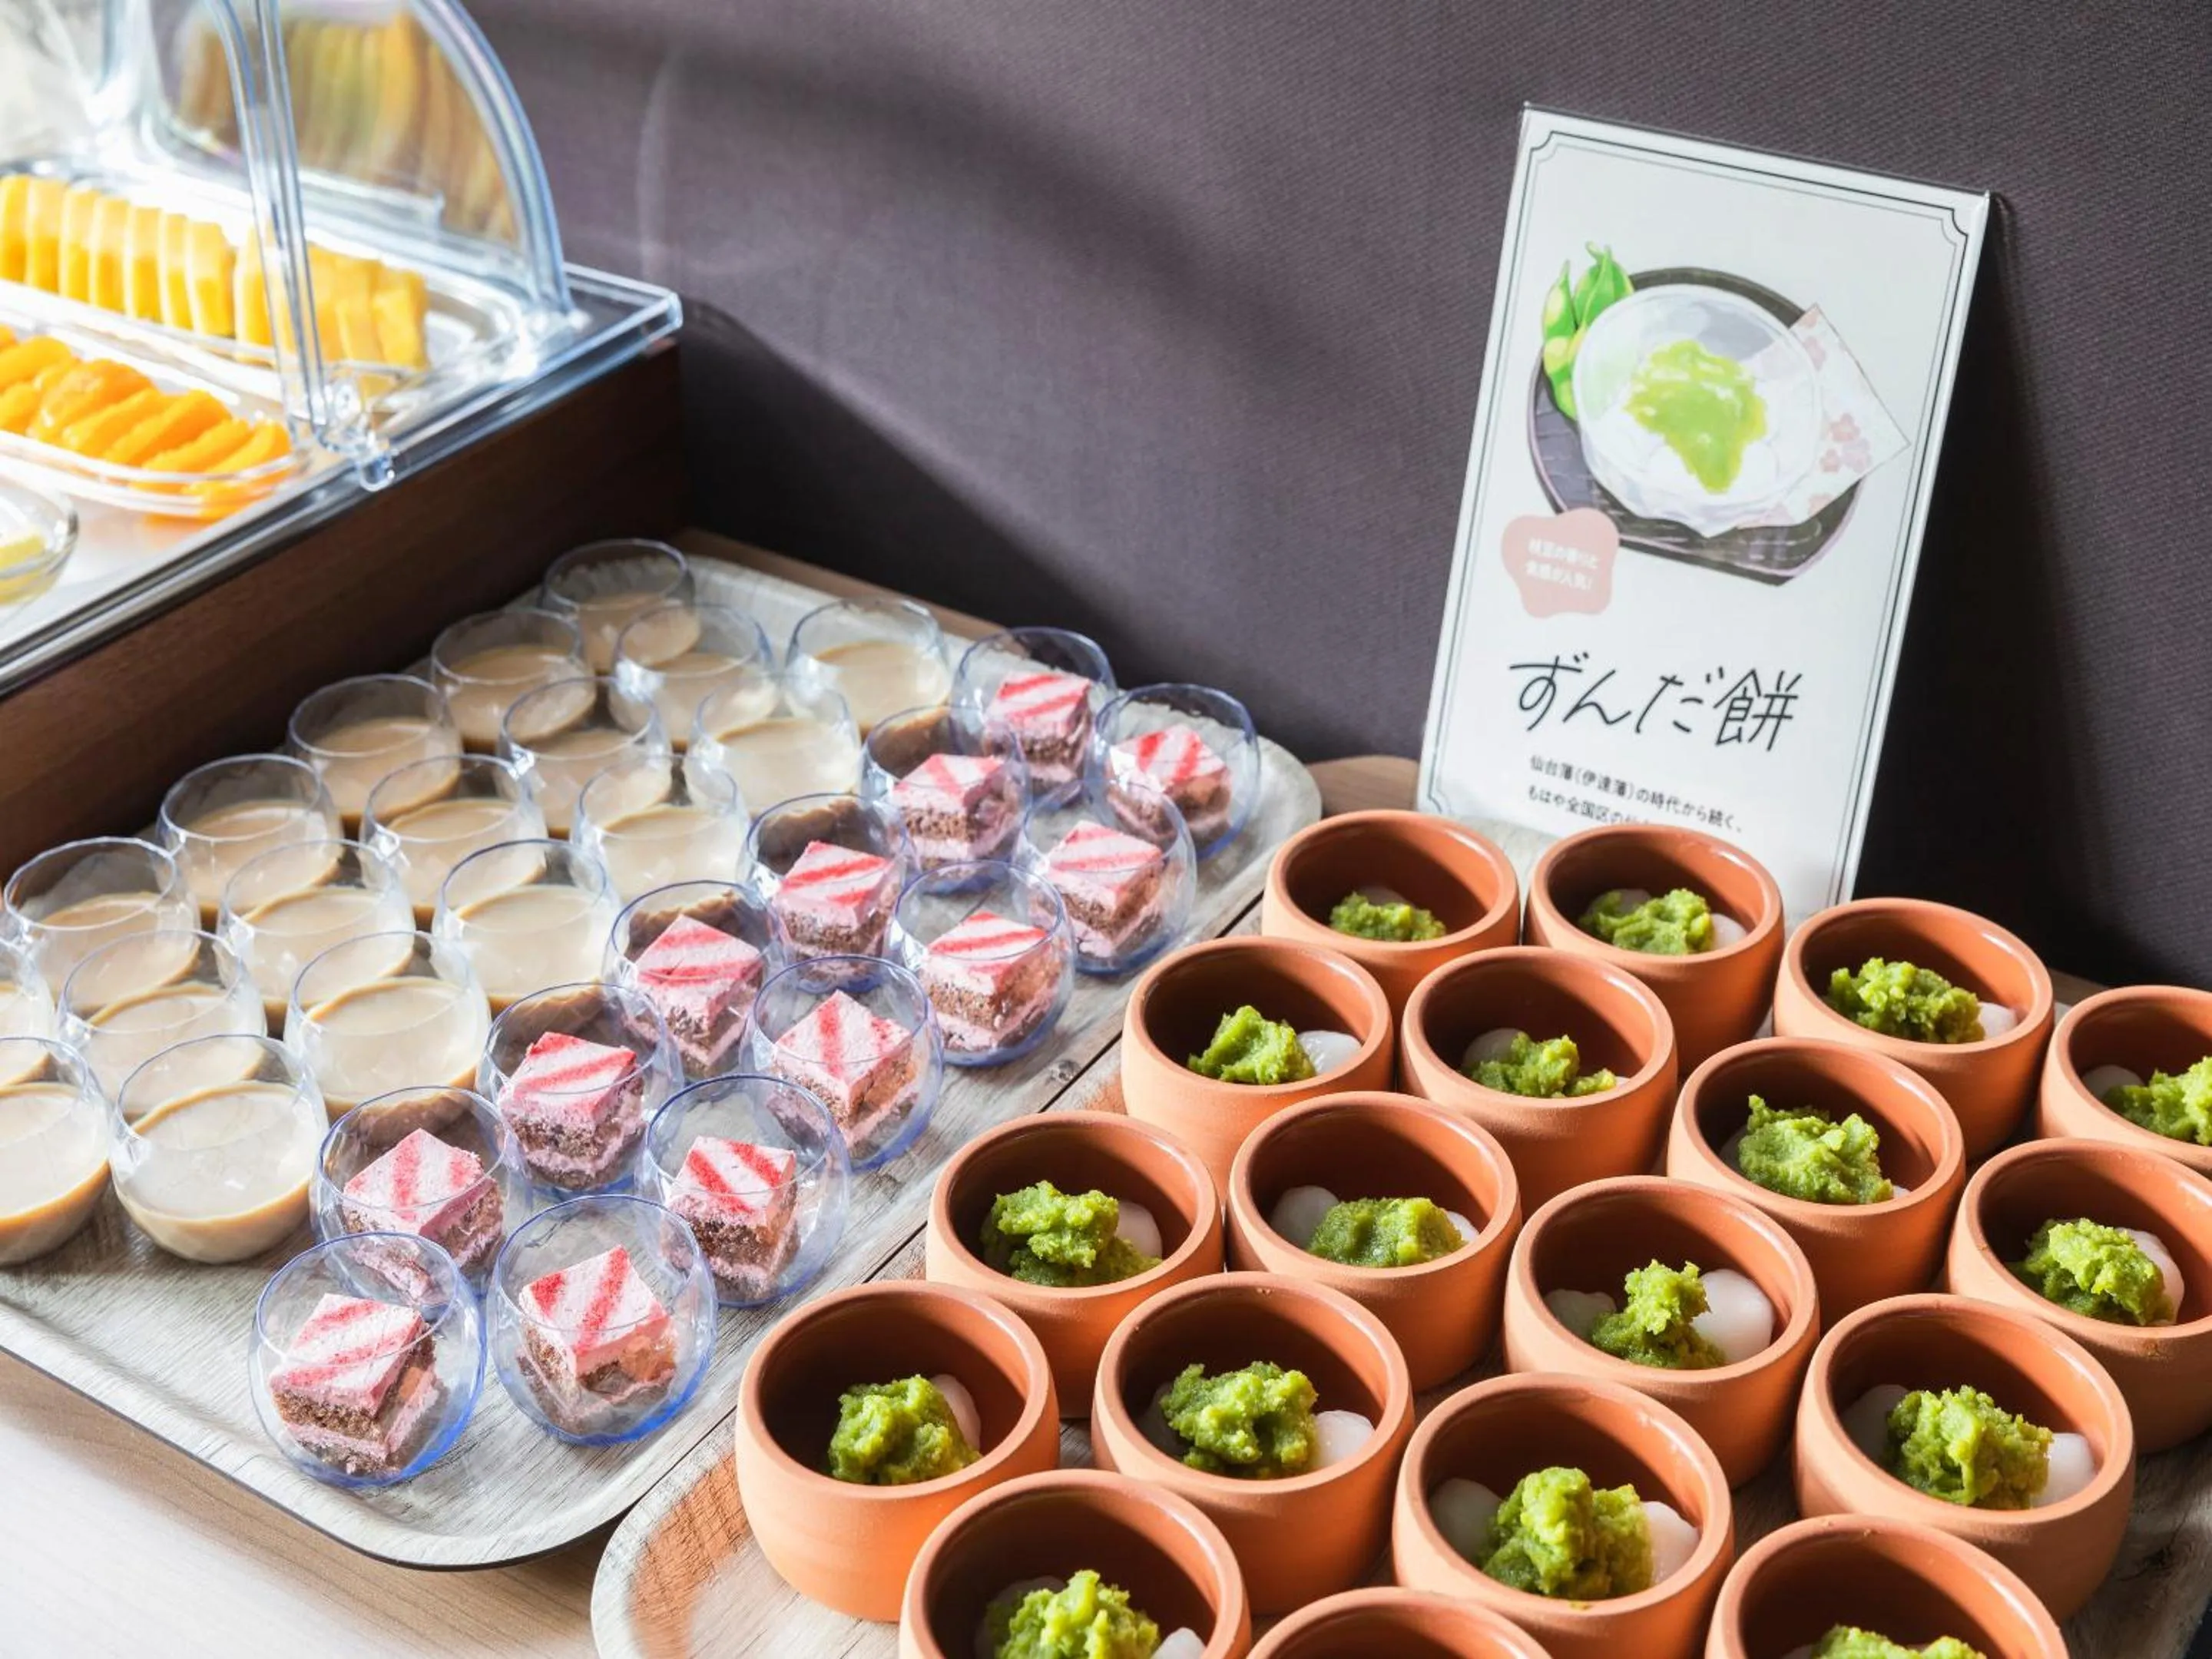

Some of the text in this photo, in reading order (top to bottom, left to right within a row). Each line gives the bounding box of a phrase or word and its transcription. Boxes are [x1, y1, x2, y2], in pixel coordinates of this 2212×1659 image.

[1508, 651, 1803, 752] ずんだ餅
[1528, 784, 1649, 825] もはや全国区の
